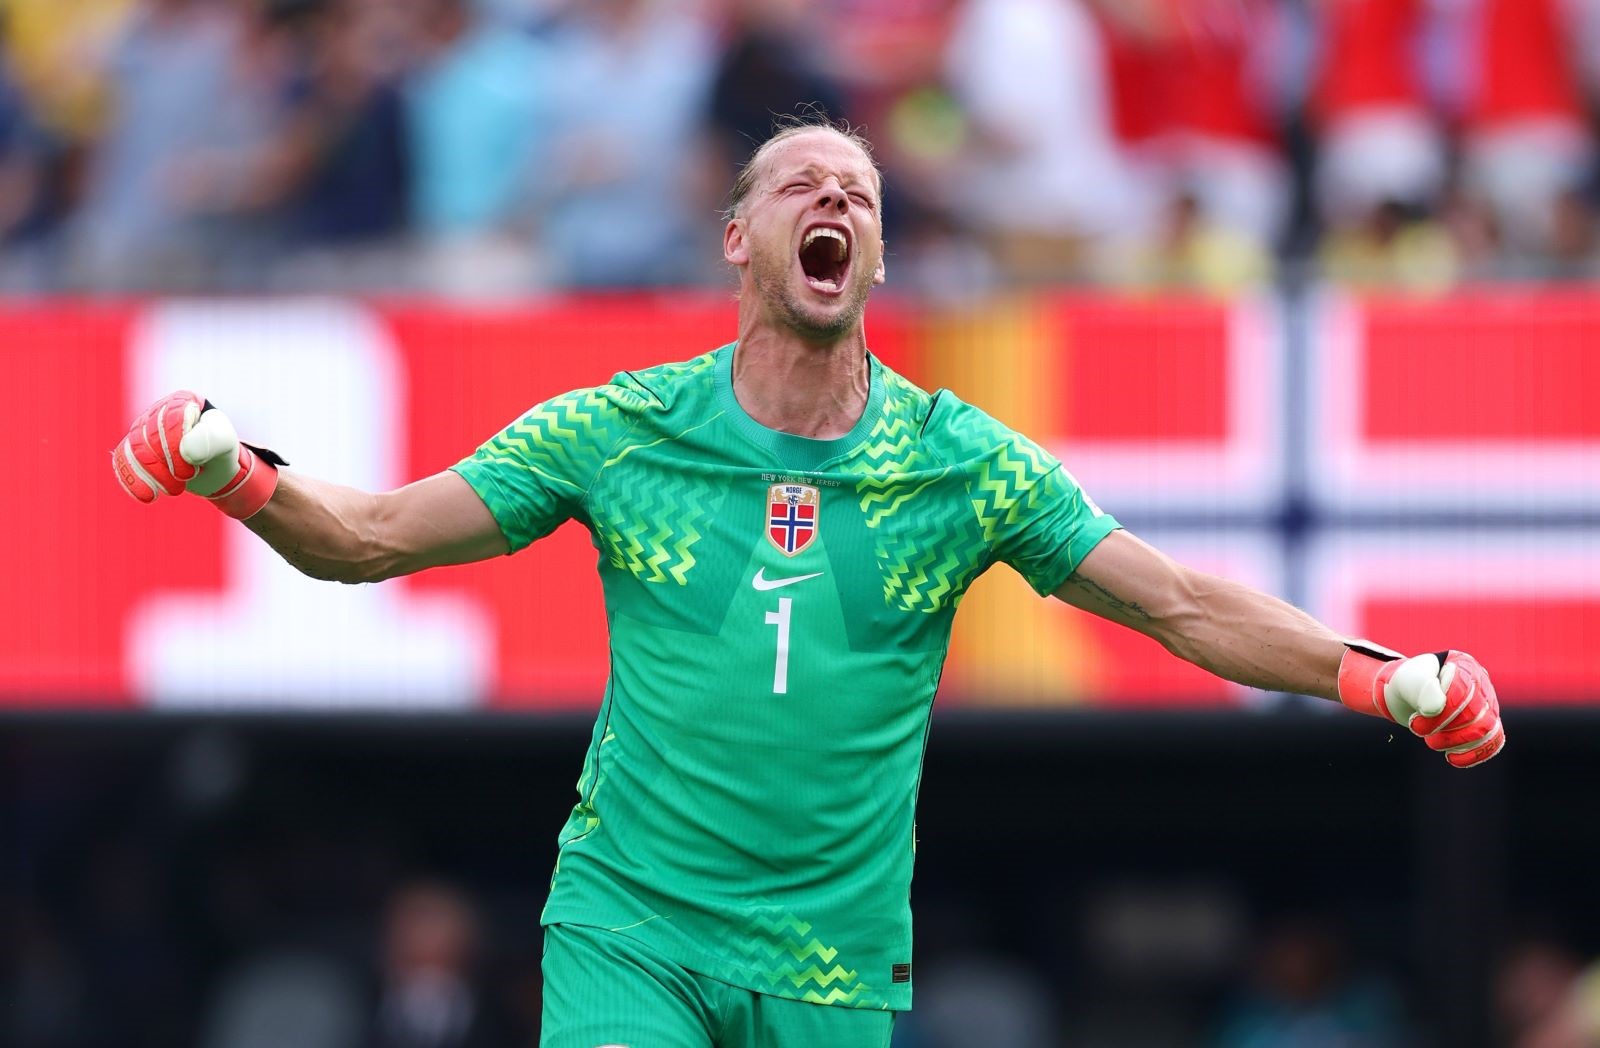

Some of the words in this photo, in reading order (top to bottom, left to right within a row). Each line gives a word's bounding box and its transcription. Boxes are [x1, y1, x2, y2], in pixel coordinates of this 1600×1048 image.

[761, 473, 776, 482] NEW
[777, 474, 795, 483] YORK
[797, 476, 813, 484] NEW
[815, 479, 841, 487] JERSEY
[785, 486, 802, 494] NORGE
[765, 597, 792, 694] 1
